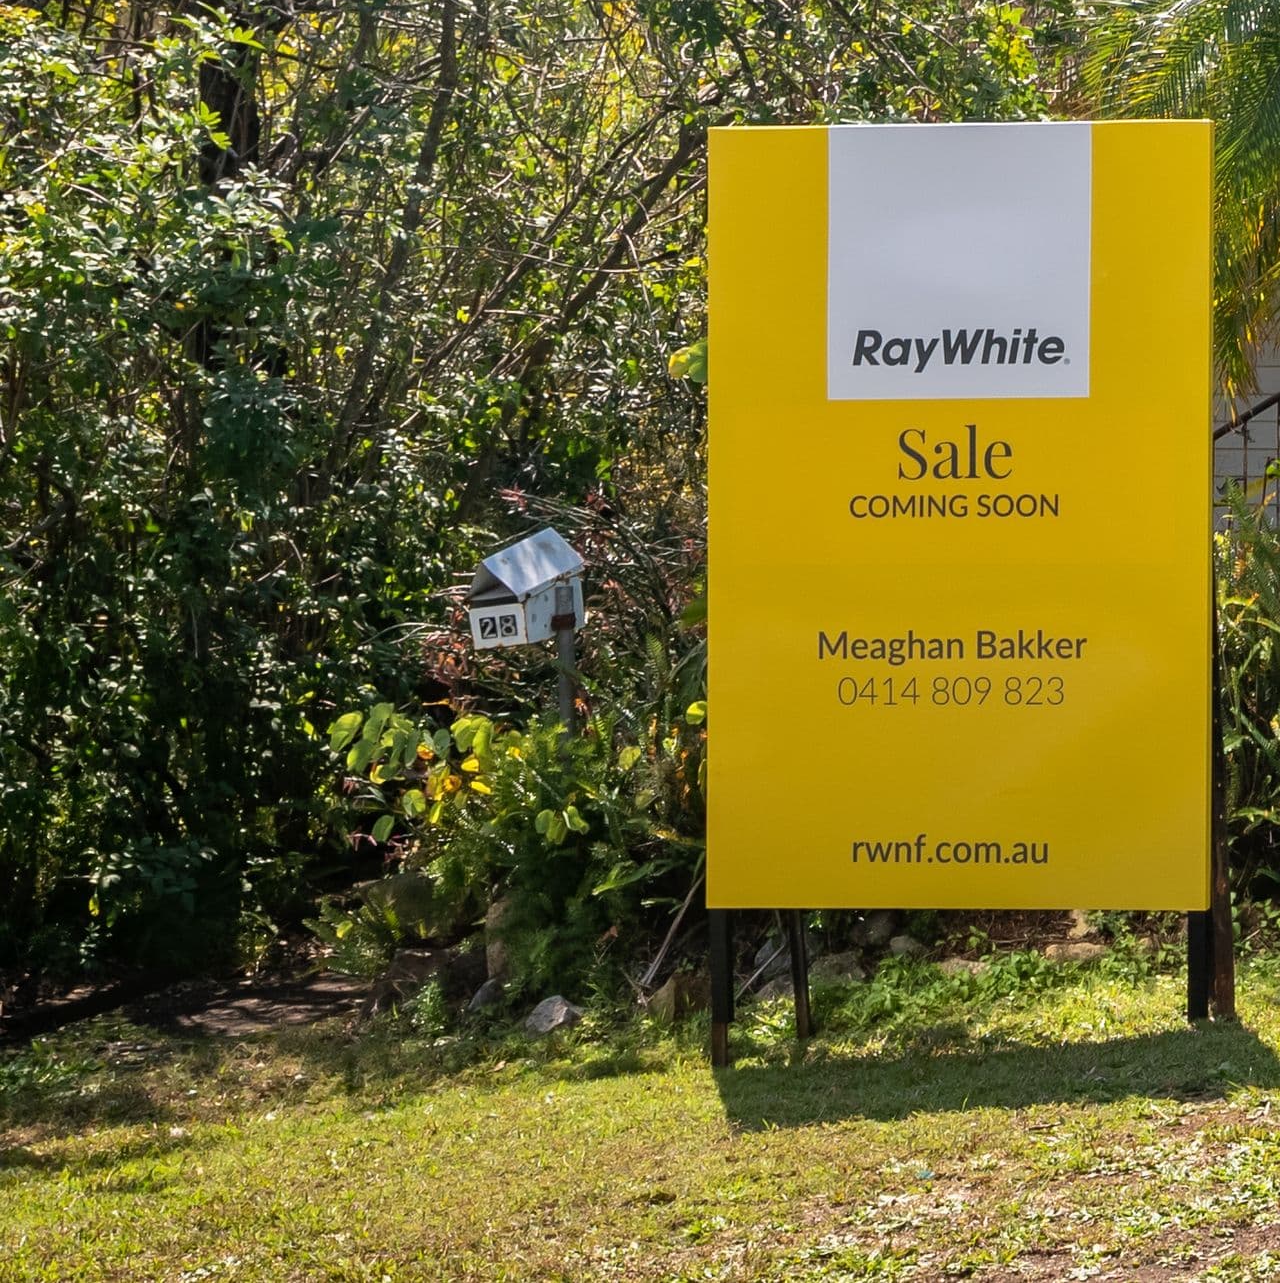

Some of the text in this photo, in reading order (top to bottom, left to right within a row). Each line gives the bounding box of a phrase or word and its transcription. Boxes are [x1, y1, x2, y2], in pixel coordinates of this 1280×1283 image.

[898, 424, 1013, 481] Sale
[849, 493, 1060, 519] COMING SOON
[480, 615, 517, 640] 28
[818, 629, 1088, 667] Meaghan Bakker
[837, 676, 1065, 706] 0414 809 823
[851, 833, 1049, 865] rwnf.com.au
